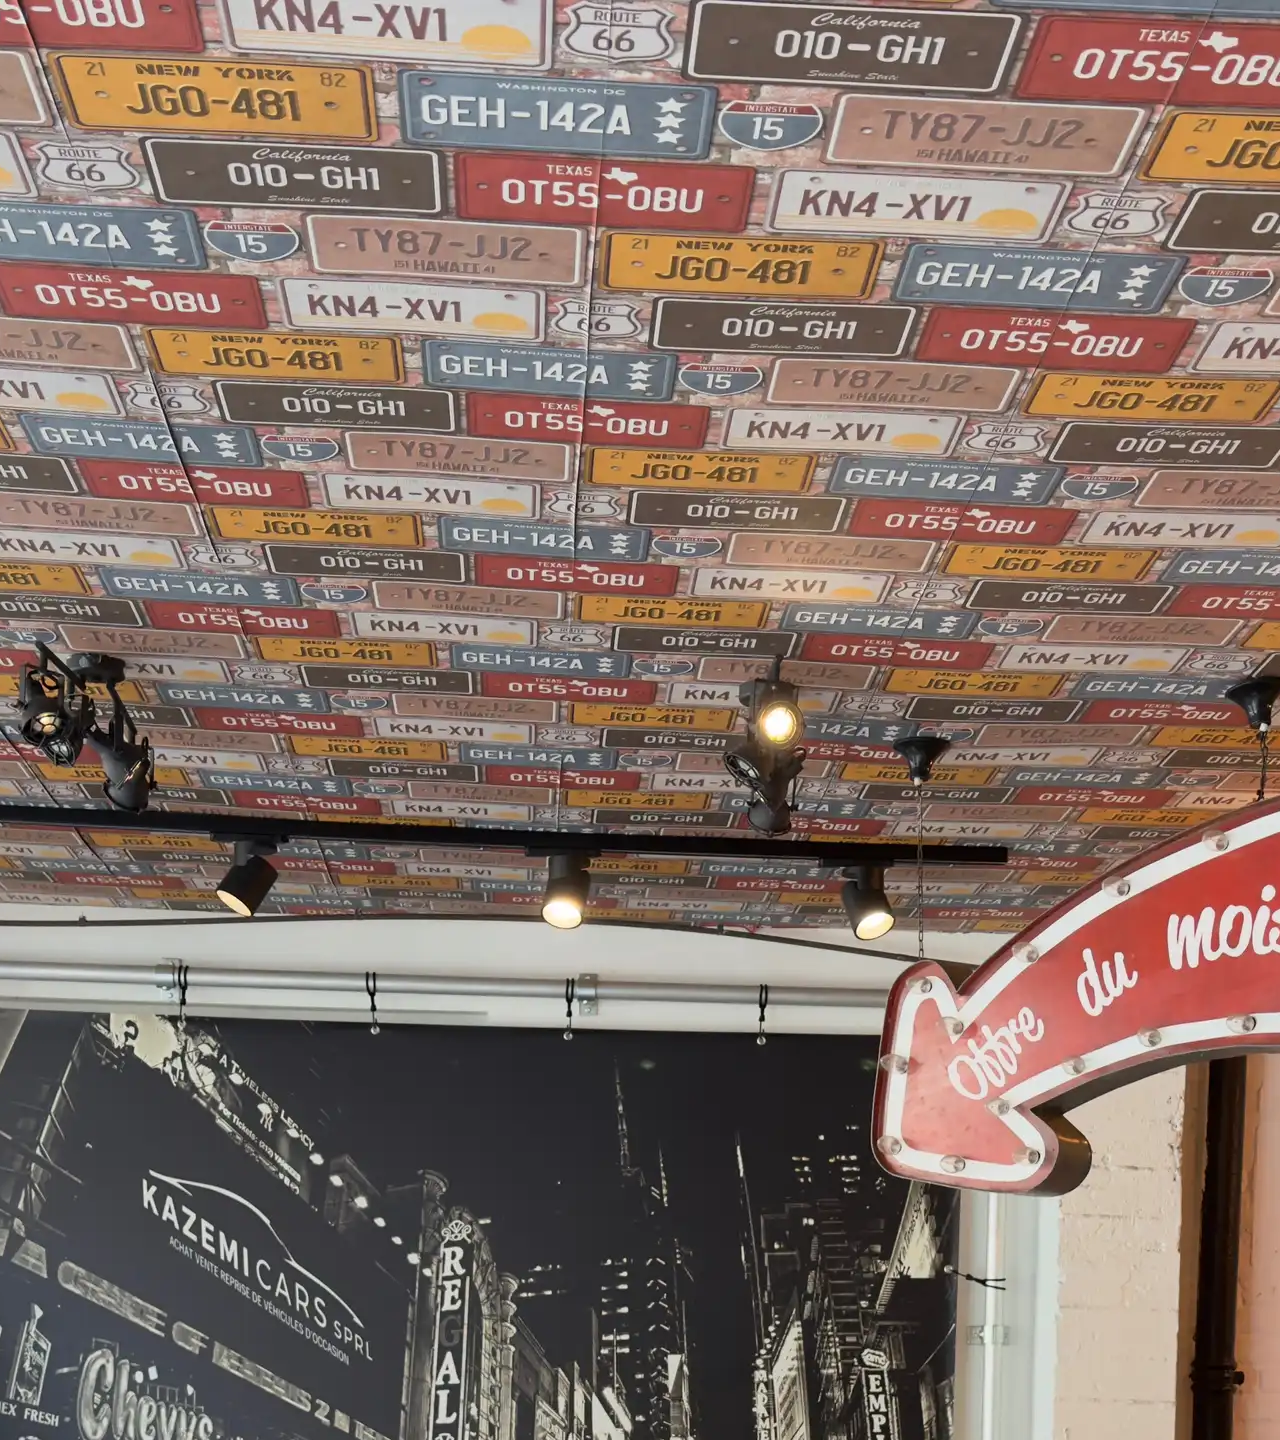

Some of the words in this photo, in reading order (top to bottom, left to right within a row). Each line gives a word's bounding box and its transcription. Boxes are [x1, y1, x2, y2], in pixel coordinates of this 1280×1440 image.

[593, 9, 642, 23] ROUTE
[810, 11, 924, 32] California
[591, 28, 637, 53] 66
[1134, 27, 1193, 42] TEXAS
[134, 61, 202, 77] NEW
[214, 65, 294, 81] YORK
[421, 93, 636, 135] GEH-142A
[747, 116, 787, 141] 15
[875, 109, 1088, 149] TY87-JJ2
[57, 147, 102, 158] ROUTE
[251, 147, 351, 165] California
[62, 162, 107, 182] 66
[545, 163, 593, 176] TEXAS
[66, 272, 112, 282] TEXAS
[913, 261, 1111, 293] GEH-142A
[440, 356, 612, 384] GEH-142A
[453, 528, 596, 549] GEH-142A
[462, 652, 585, 669] GEH-142A
[948, 1006, 1045, 1100] Offre
[1076, 947, 1138, 1017] du
[231, 1060, 279, 1113] TMELESS
[142, 1178, 249, 1277] KAZEMI
[255, 1259, 328, 1329] CARS
[333, 1319, 373, 1361] SPRL
[169, 1235, 193, 1260] ACHAT
[194, 1252, 220, 1279] VENTE
[220, 1268, 251, 1299] REPRISE
[252, 1290, 263, 1308] DE
[263, 1300, 304, 1337] VÉHICULES
[304, 1326, 350, 1366] D'OCCASION
[432, 1244, 466, 1426] REGAL
[23, 1407, 60, 1428] FRESH
